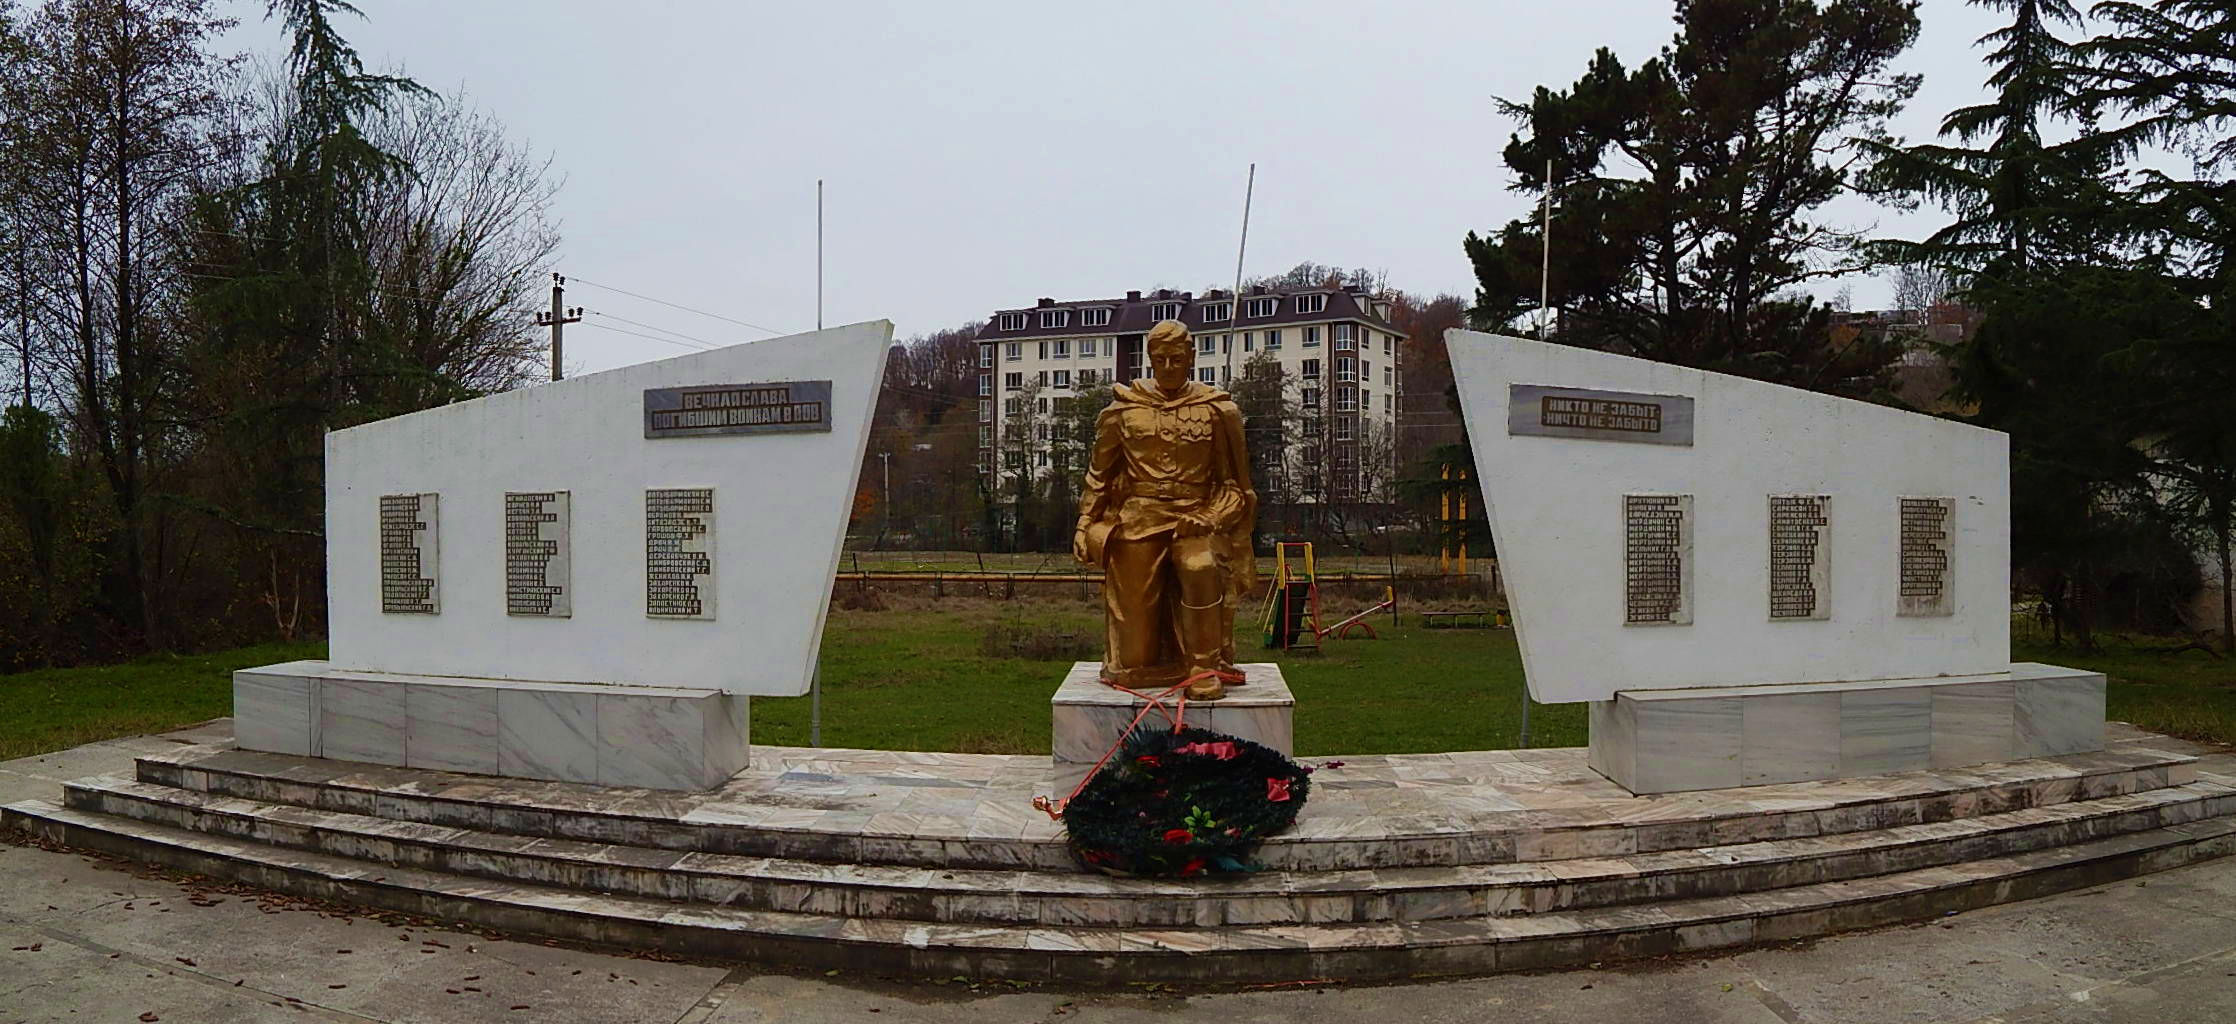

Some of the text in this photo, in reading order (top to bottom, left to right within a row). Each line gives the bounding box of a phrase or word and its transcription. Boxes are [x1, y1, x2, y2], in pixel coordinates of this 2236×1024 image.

[686, 389, 785, 408] ВЕЧНАЯ СЛАВА
[730, 408, 781, 424] ВОИНАМ
[784, 407, 791, 421] В
[1550, 400, 1588, 413] НИКТО
[1593, 401, 1607, 415] НЕ
[1589, 416, 1606, 427] НЕ
[1608, 417, 1657, 430] ЗАБЫТО
